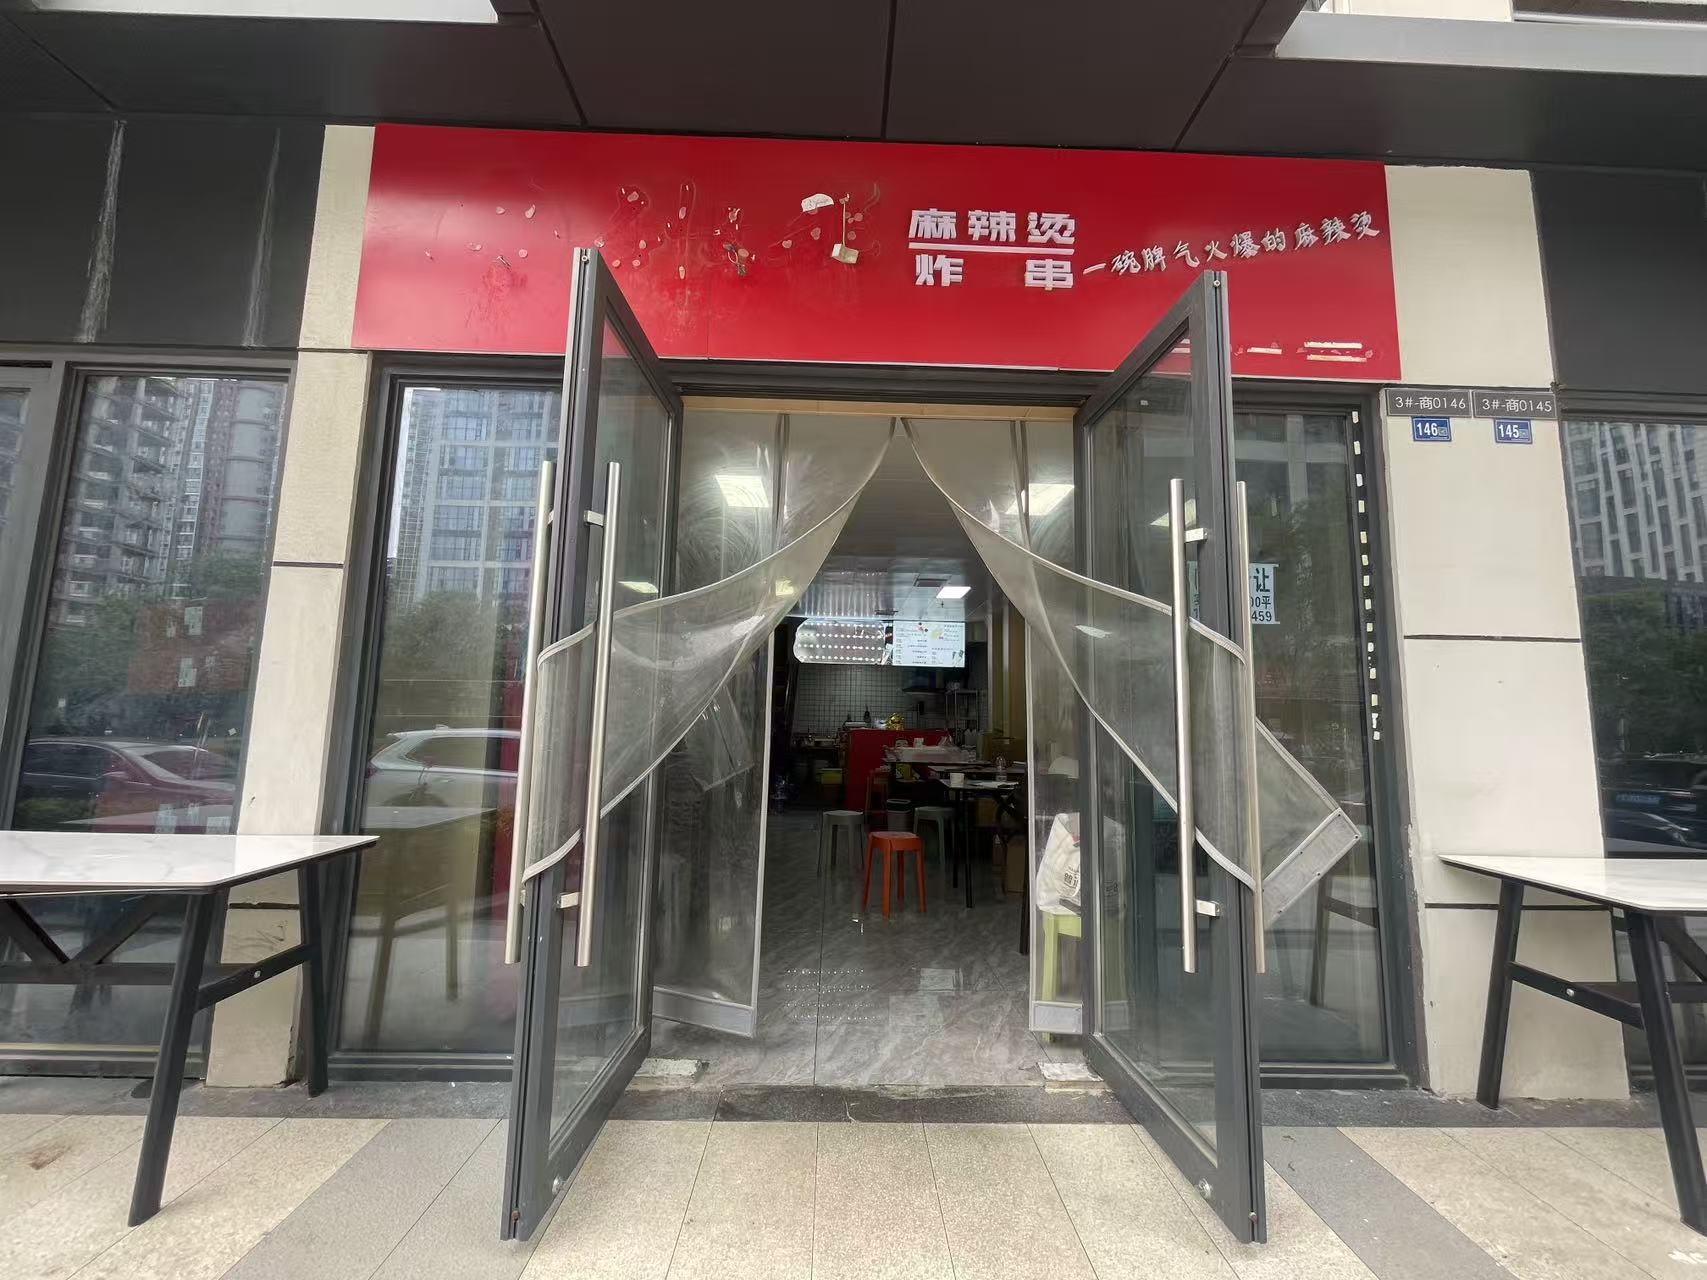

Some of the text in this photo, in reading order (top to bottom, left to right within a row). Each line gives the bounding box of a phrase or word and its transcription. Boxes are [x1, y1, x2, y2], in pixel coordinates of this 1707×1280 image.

[908, 208, 1075, 244] 麻辣烫
[1395, 396, 1466, 410] 3#-商0146
[1482, 398, 1552, 412] 3#-商0145
[1417, 423, 1438, 436] 146
[1499, 424, 1519, 438] 145
